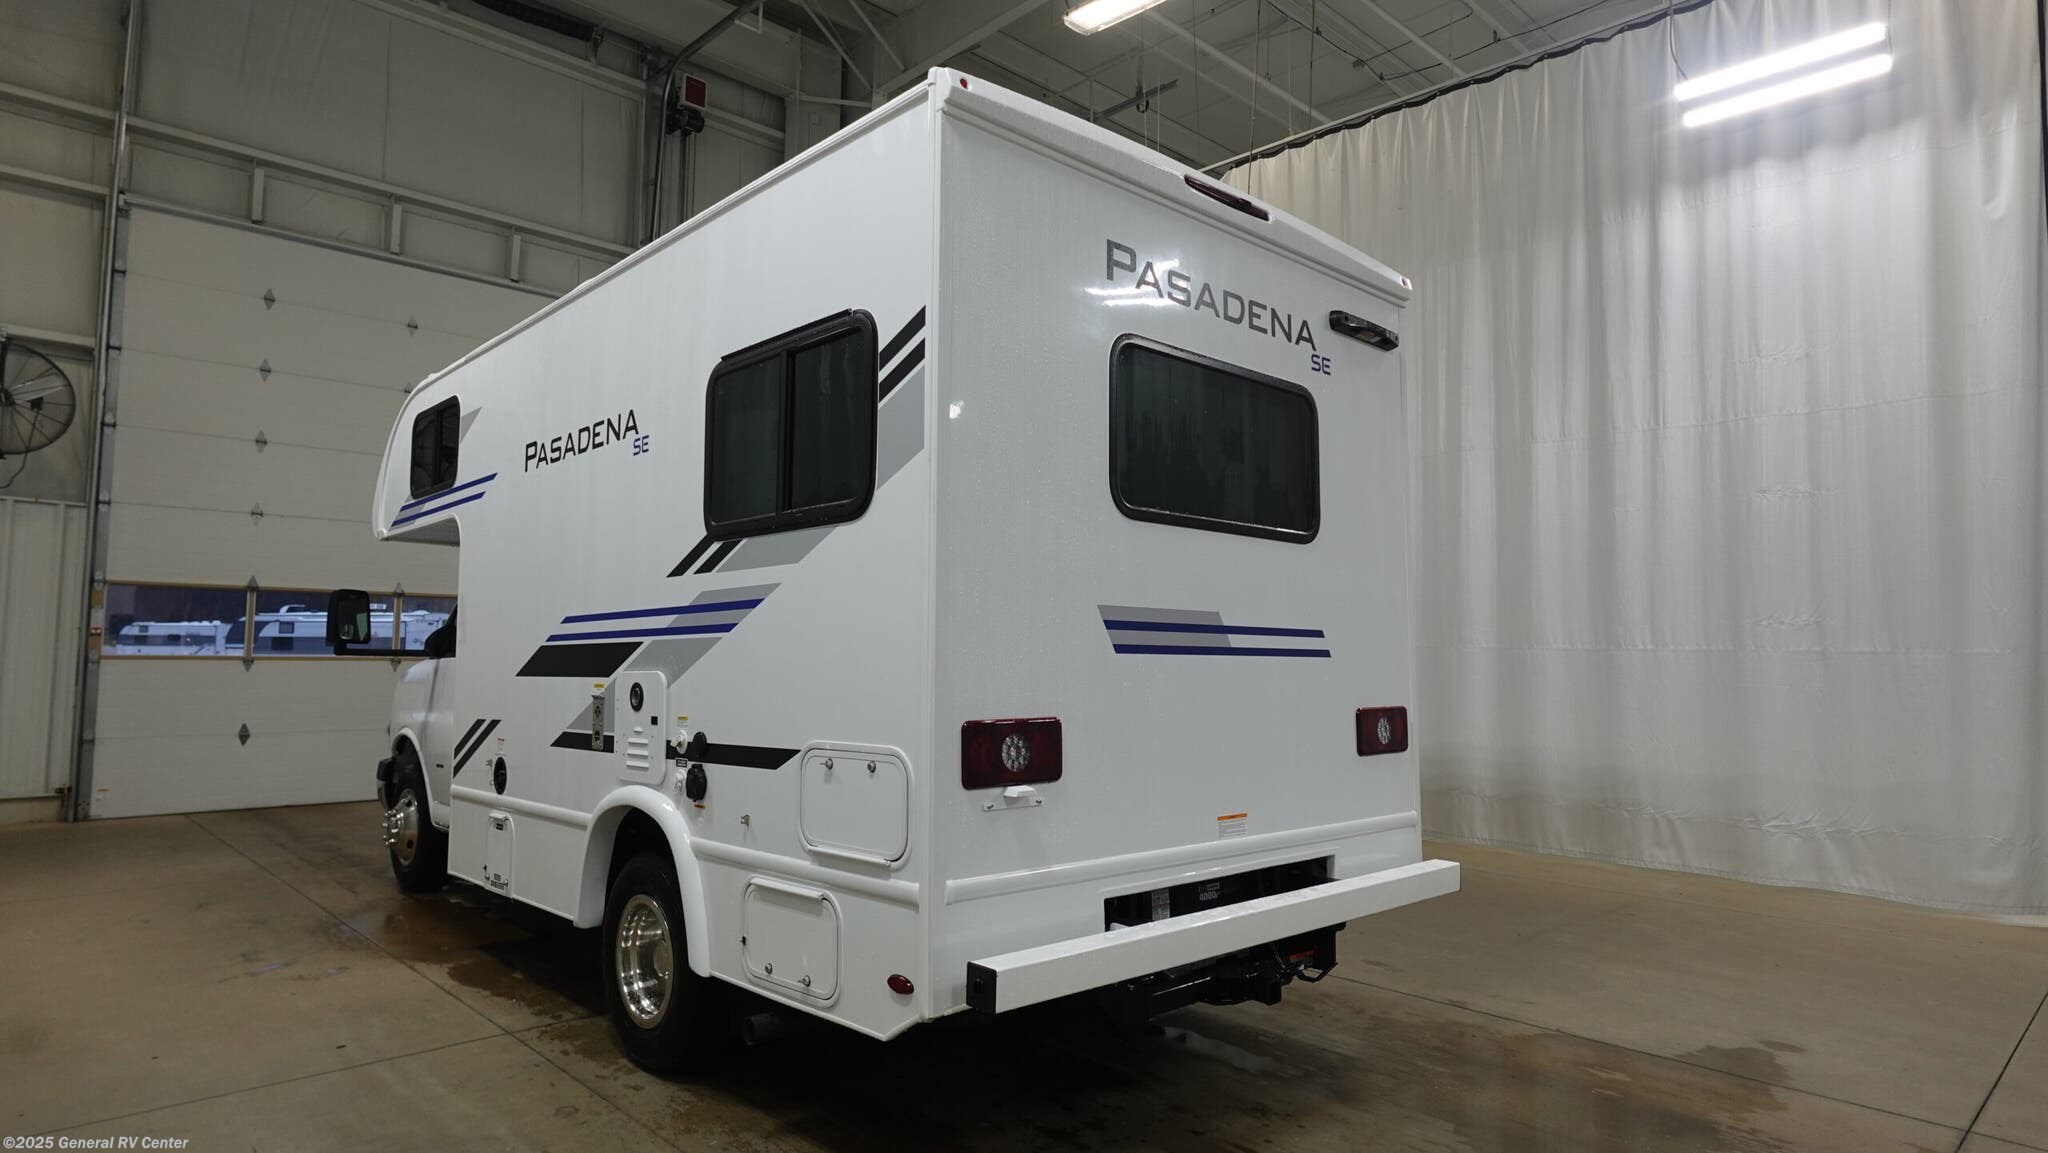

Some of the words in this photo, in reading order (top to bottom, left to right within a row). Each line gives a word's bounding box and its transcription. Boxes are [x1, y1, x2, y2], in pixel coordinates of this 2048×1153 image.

[1106, 238, 1317, 351] PASADENA
[1311, 354, 1331, 376] SE
[524, 408, 640, 473] PASADENA
[632, 434, 650, 456] SE
